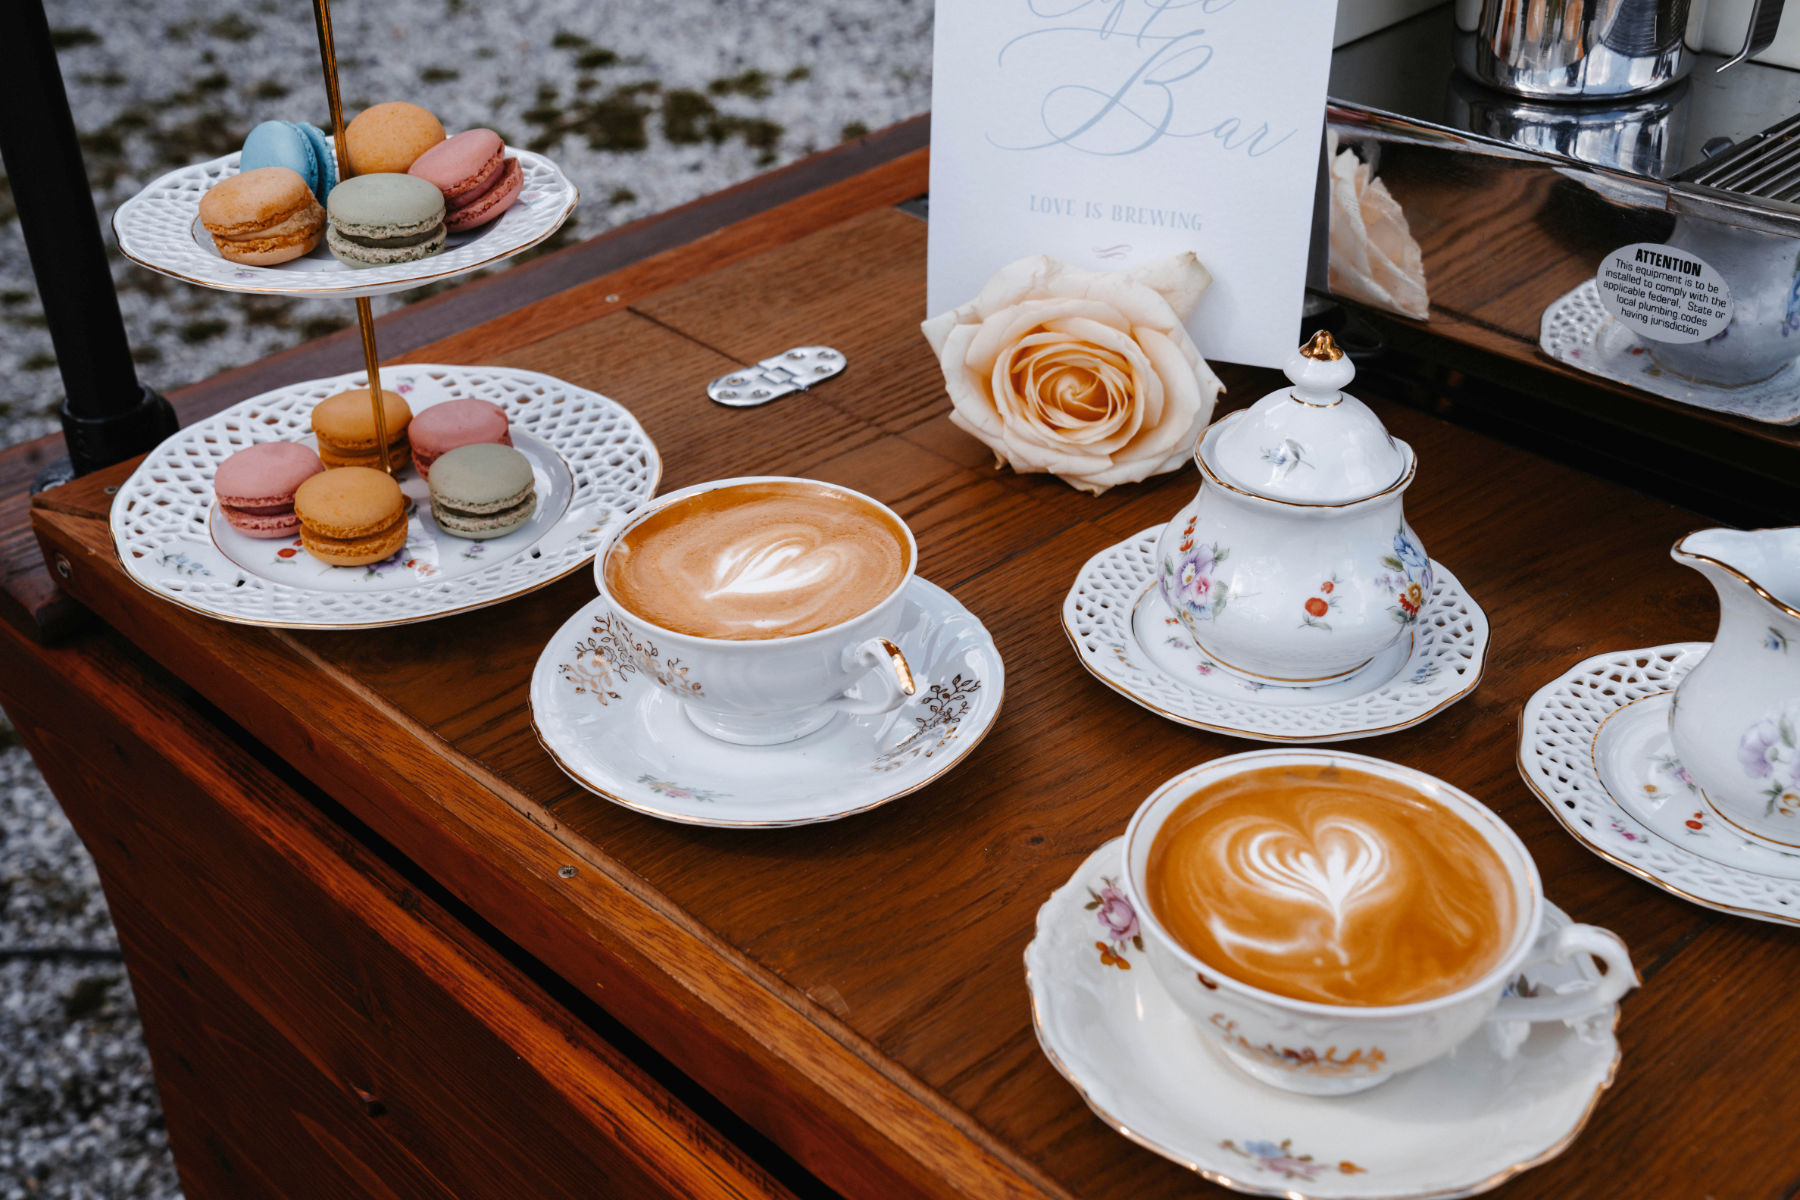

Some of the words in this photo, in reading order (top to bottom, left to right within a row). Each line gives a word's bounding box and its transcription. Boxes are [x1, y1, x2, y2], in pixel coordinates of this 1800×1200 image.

[985, 28, 1298, 157] Bar
[1029, 194, 1076, 217] LOVE
[1084, 201, 1103, 220] IS
[1111, 204, 1203, 232] BREWING
[1616, 258, 1633, 271] This
[1636, 266, 1682, 284] equipment
[1685, 276, 1692, 287] is
[1695, 281, 1705, 290] to
[1707, 282, 1719, 293] be
[1635, 248, 1702, 277] ATTENTION
[1603, 280, 1646, 298] applicable
[1687, 301, 1713, 316] State
[1715, 310, 1726, 319] or
[1605, 267, 1641, 285] installed
[1644, 279, 1653, 288] to
[1655, 283, 1687, 299] comply
[1689, 291, 1709, 303] with
[1711, 296, 1727, 308] the
[1616, 293, 1637, 307] local
[1638, 301, 1678, 320] plumbing
[1680, 313, 1708, 327] codes
[1621, 307, 1648, 324] having
[1650, 314, 1699, 336] jurisdiction
